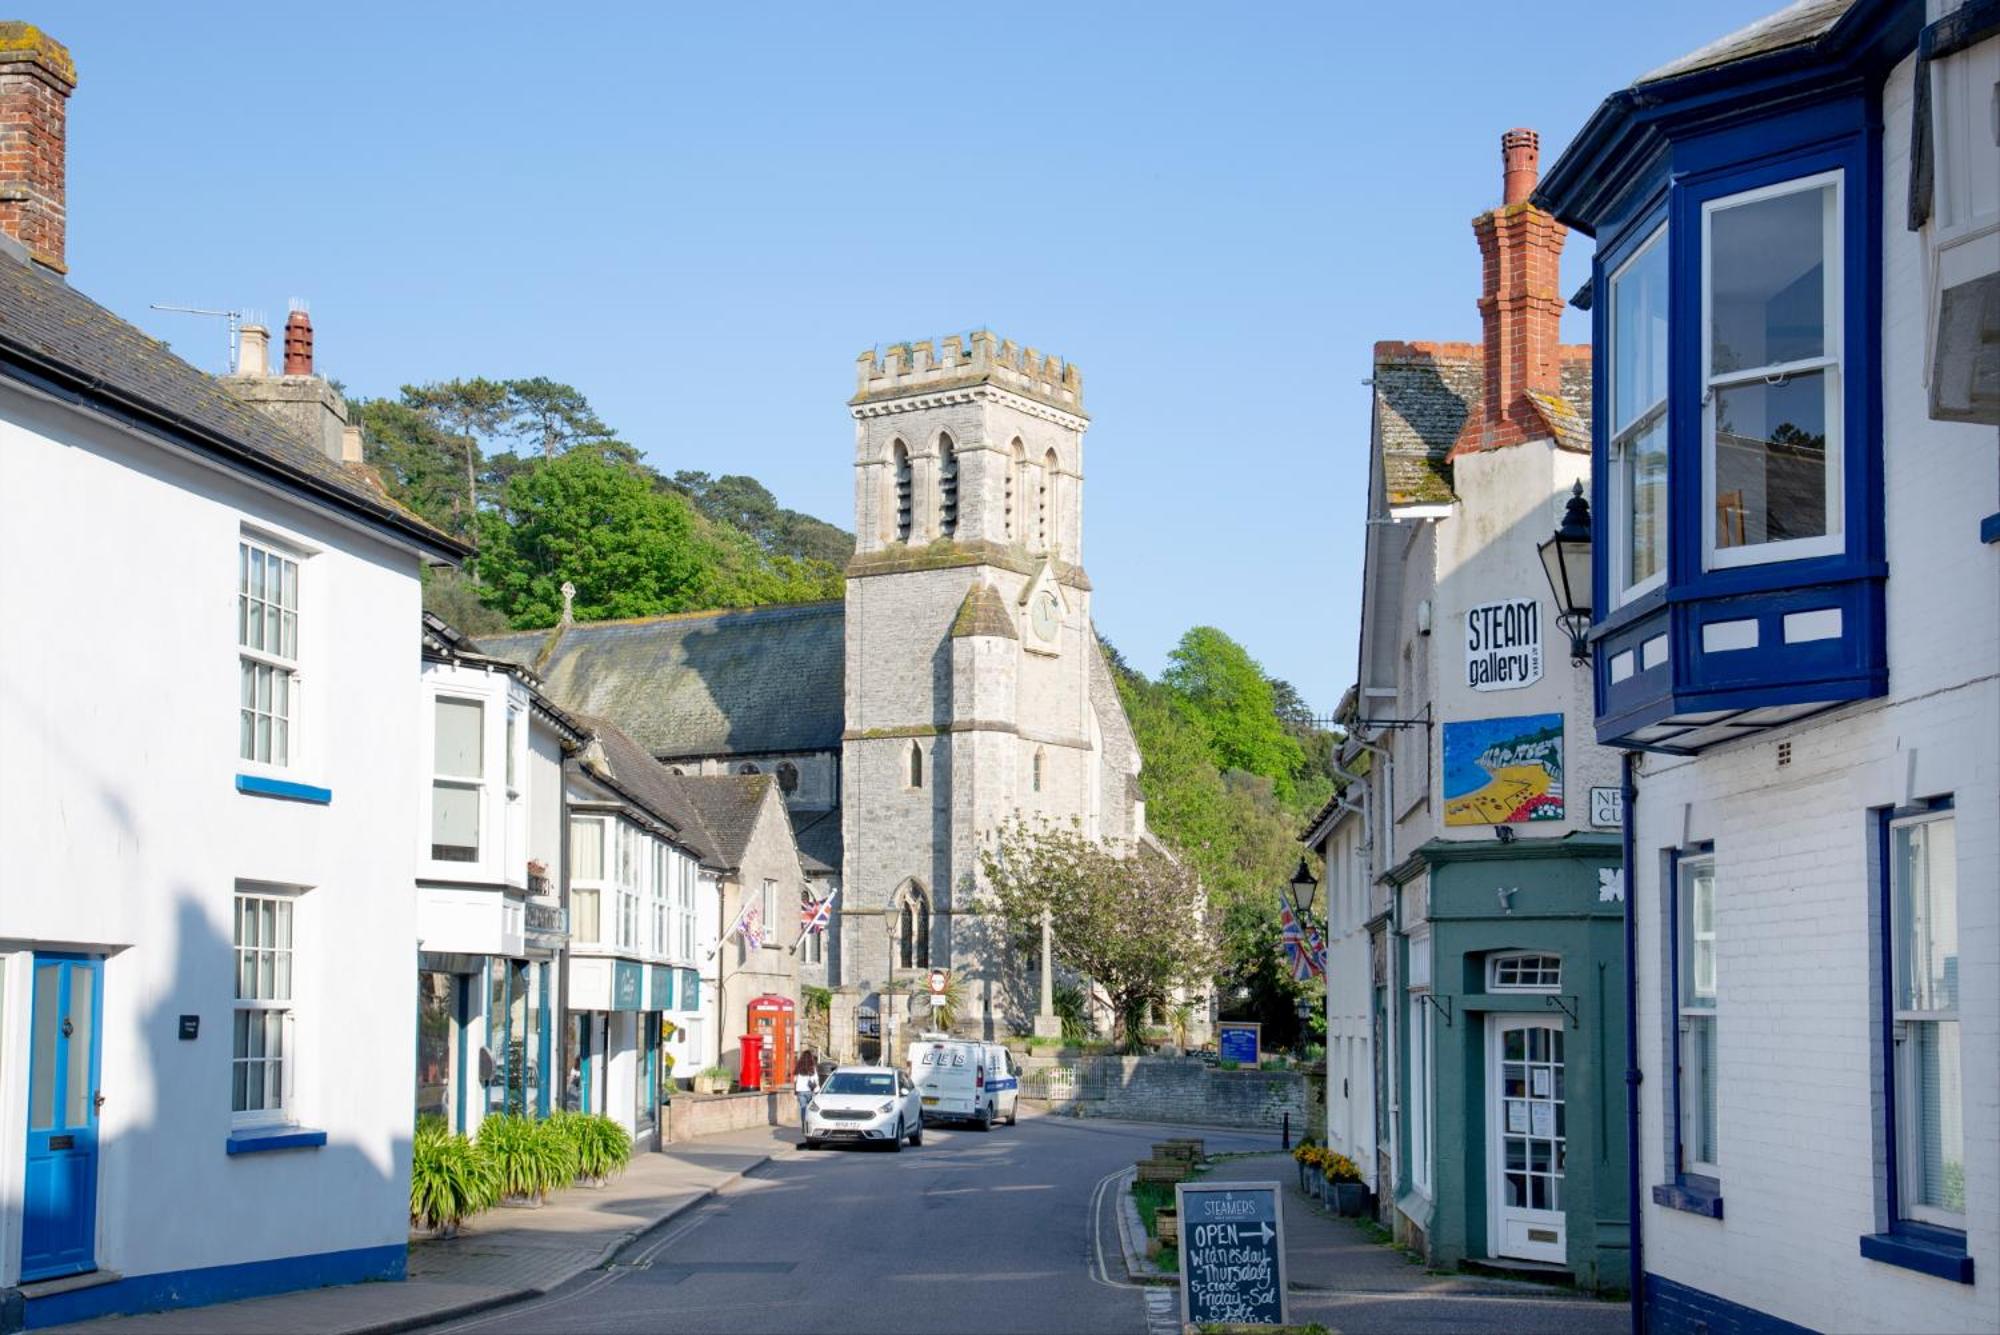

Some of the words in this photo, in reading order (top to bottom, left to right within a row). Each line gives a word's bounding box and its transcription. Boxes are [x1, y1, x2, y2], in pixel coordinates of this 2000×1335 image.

[1469, 601, 1537, 651] STEAM
[1469, 652, 1529, 687] gallery
[1597, 791, 1621, 806] NE
[1599, 808, 1623, 822] CU
[1204, 1199, 1256, 1216] STEAMERS
[1195, 1223, 1239, 1247] OPEN
